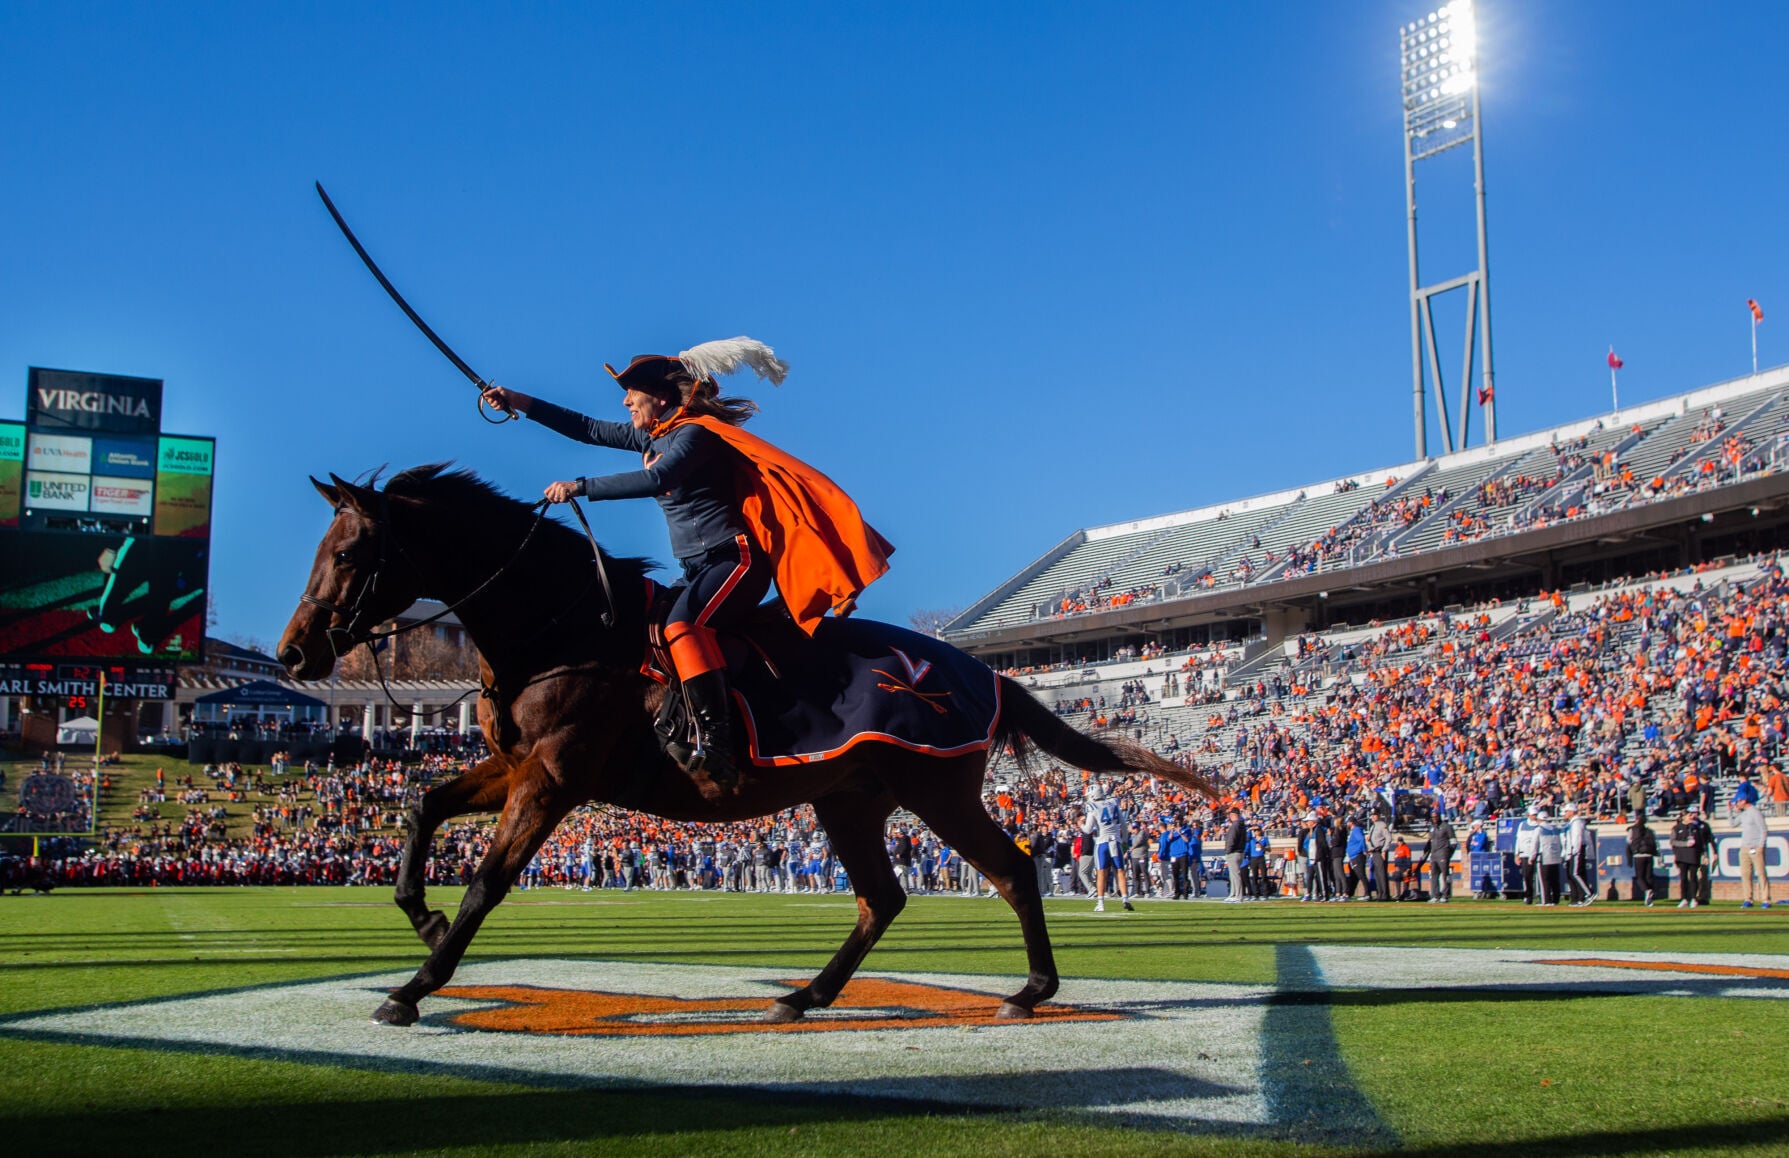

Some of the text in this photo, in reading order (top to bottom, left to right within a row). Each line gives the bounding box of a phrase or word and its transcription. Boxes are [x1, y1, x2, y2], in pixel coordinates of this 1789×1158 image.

[38, 388, 151, 418] VIRGINIA
[43, 447, 62, 456] UVA
[43, 480, 86, 492] UNITED
[43, 490, 74, 500] BANK
[97, 487, 129, 498] TIGER
[37, 681, 95, 696] SMITH
[102, 683, 168, 698] CENTER
[68, 696, 86, 708] 25
[1101, 803, 1120, 825] 44
